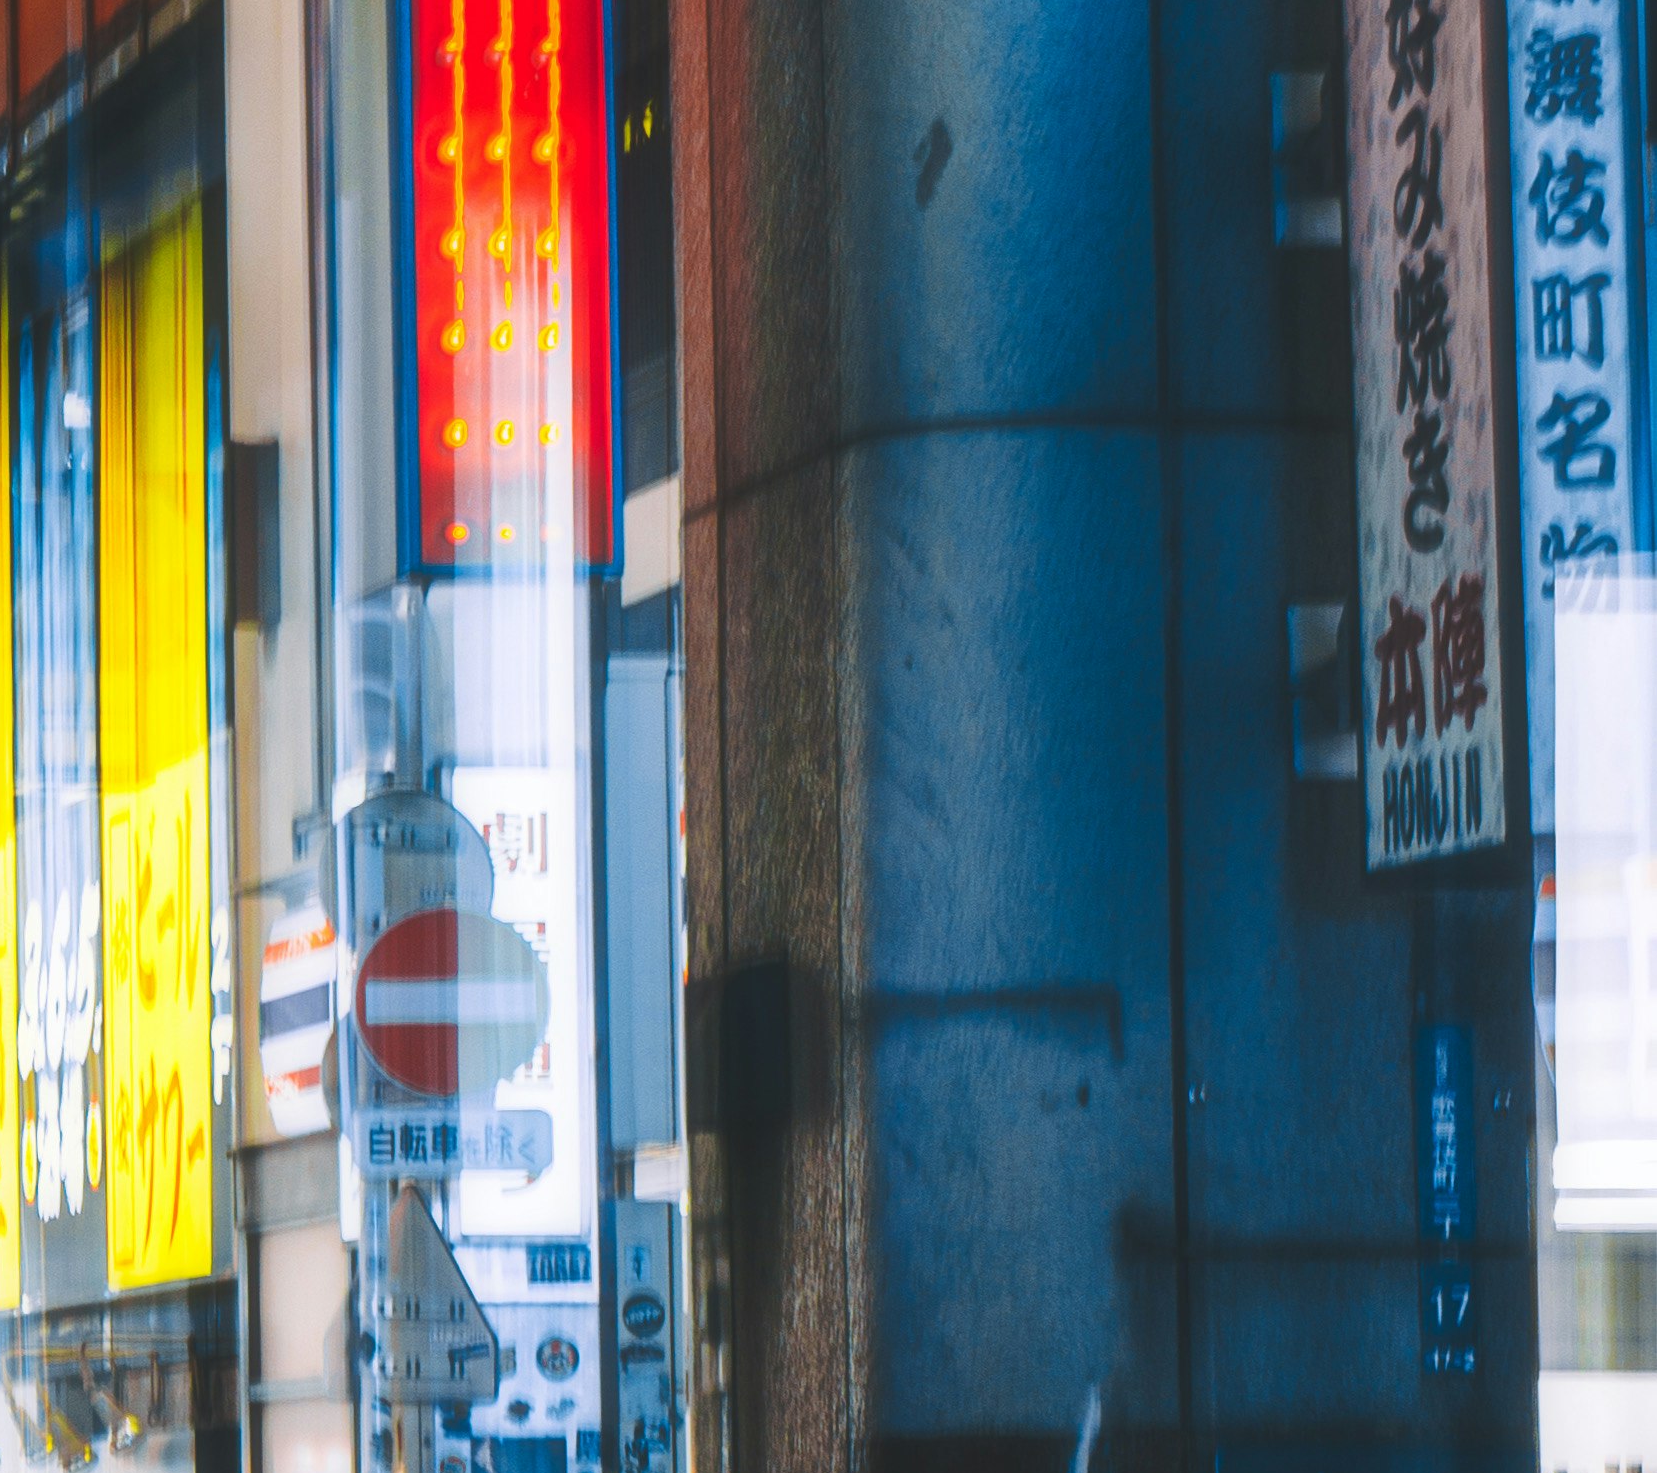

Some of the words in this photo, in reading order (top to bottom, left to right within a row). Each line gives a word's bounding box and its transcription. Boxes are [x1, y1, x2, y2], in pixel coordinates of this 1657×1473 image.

[1375, 574, 1487, 752] 本陣
[1381, 746, 1484, 855] HONJIN
[135, 790, 206, 1013] ビール
[366, 1123, 537, 1166] 自転車を除く
